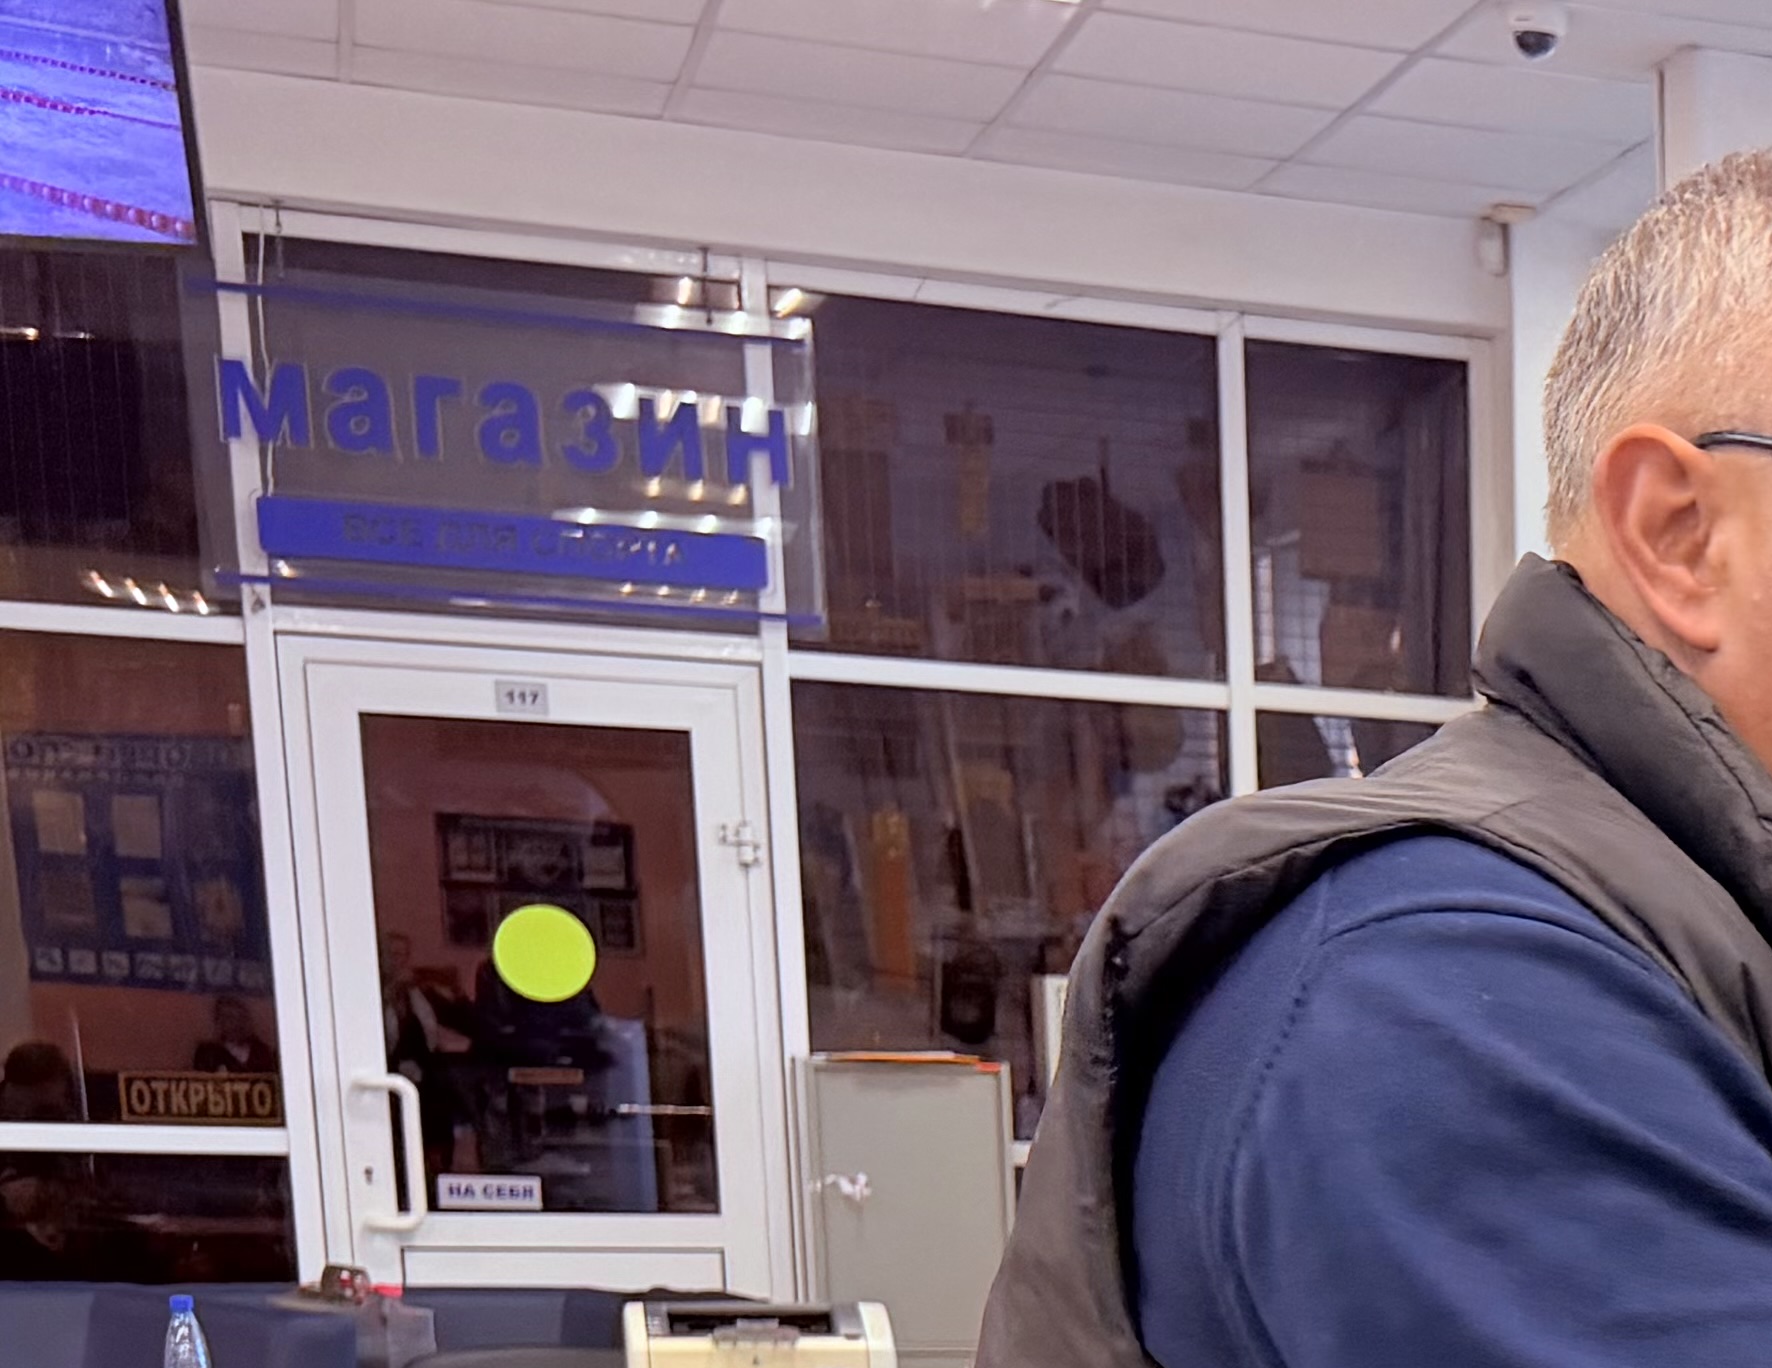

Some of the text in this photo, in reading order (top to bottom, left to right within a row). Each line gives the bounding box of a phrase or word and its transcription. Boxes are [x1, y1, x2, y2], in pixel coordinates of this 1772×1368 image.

[215, 355, 794, 489] магазин
[130, 1079, 272, 1118] ОТКРЫТО
[449, 1182, 535, 1201] НА СЕБЯ
